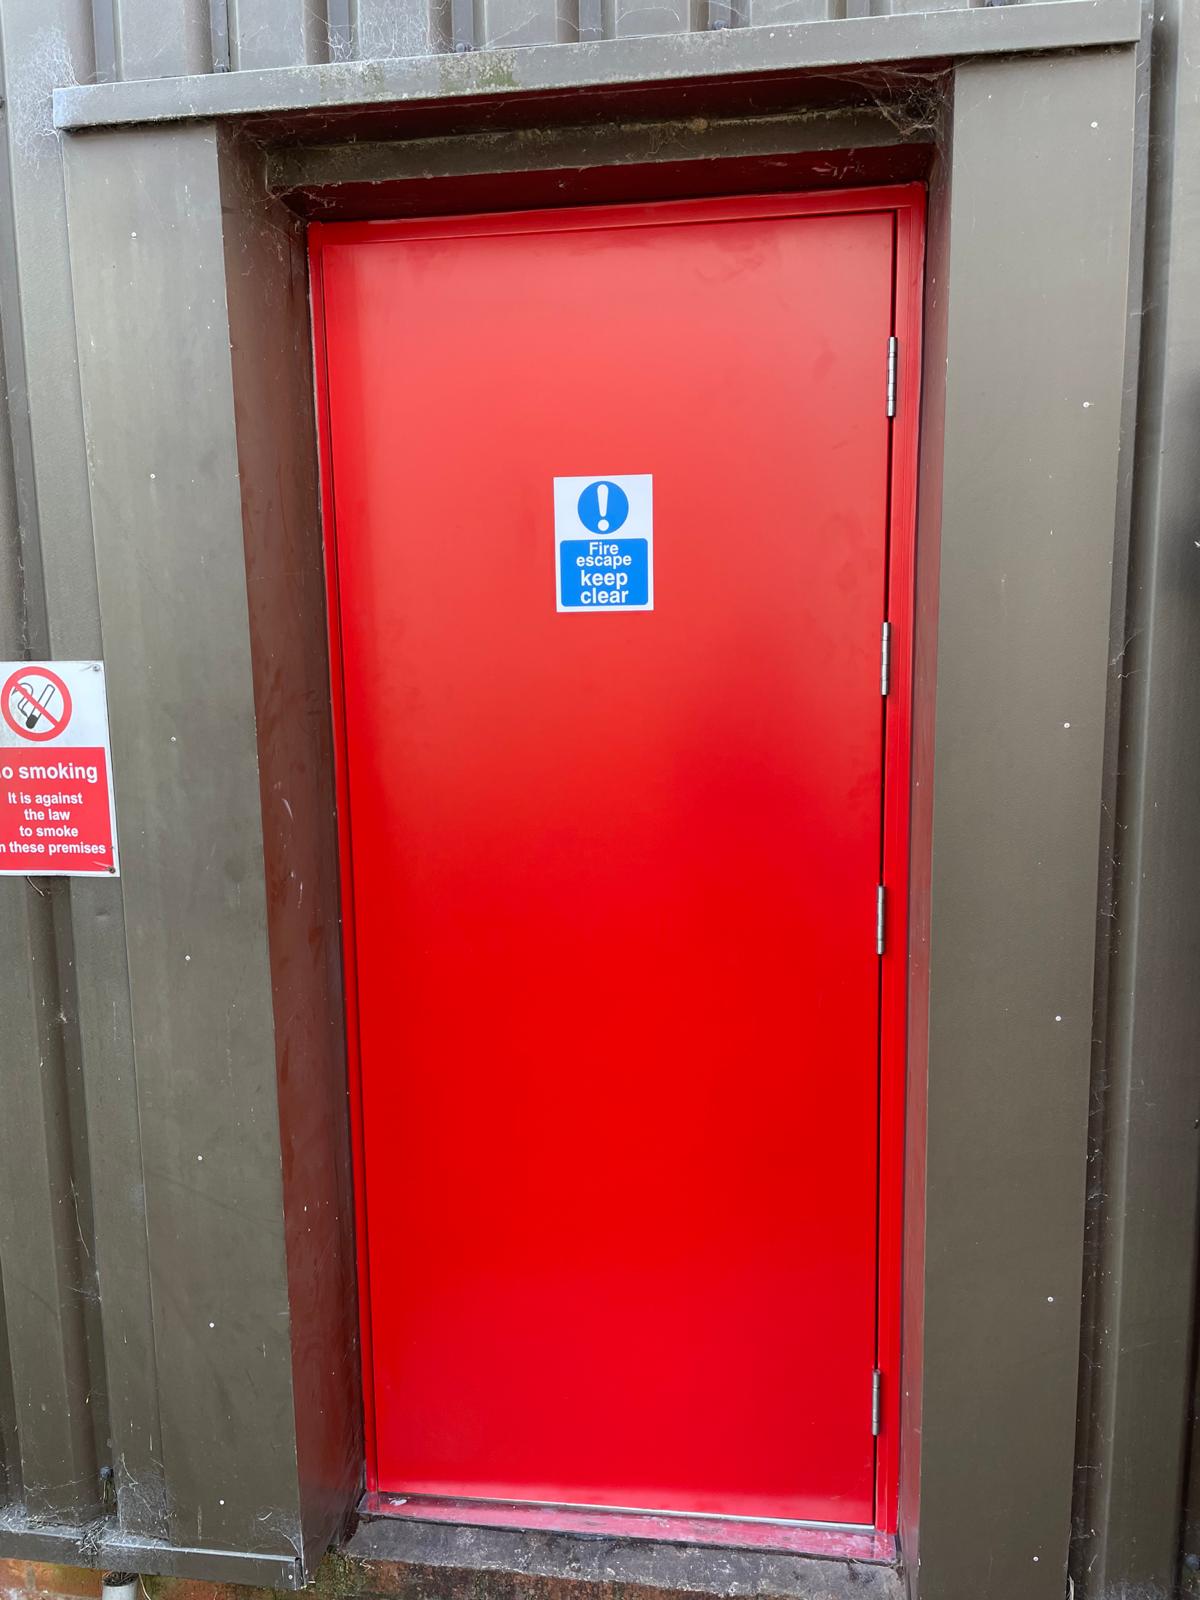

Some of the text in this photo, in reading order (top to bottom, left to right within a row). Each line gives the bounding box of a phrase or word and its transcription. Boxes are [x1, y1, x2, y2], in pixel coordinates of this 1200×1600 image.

[589, 542, 618, 555] Fire
[576, 555, 631, 569] escape
[581, 570, 628, 589] keep
[581, 588, 628, 604] clear
[0, 763, 97, 783] o smoking
[8, 792, 83, 806] It is against
[24, 809, 70, 820] the law
[20, 825, 78, 837] to smoke
[9, 842, 44, 853] these
[48, 842, 106, 855] premises
